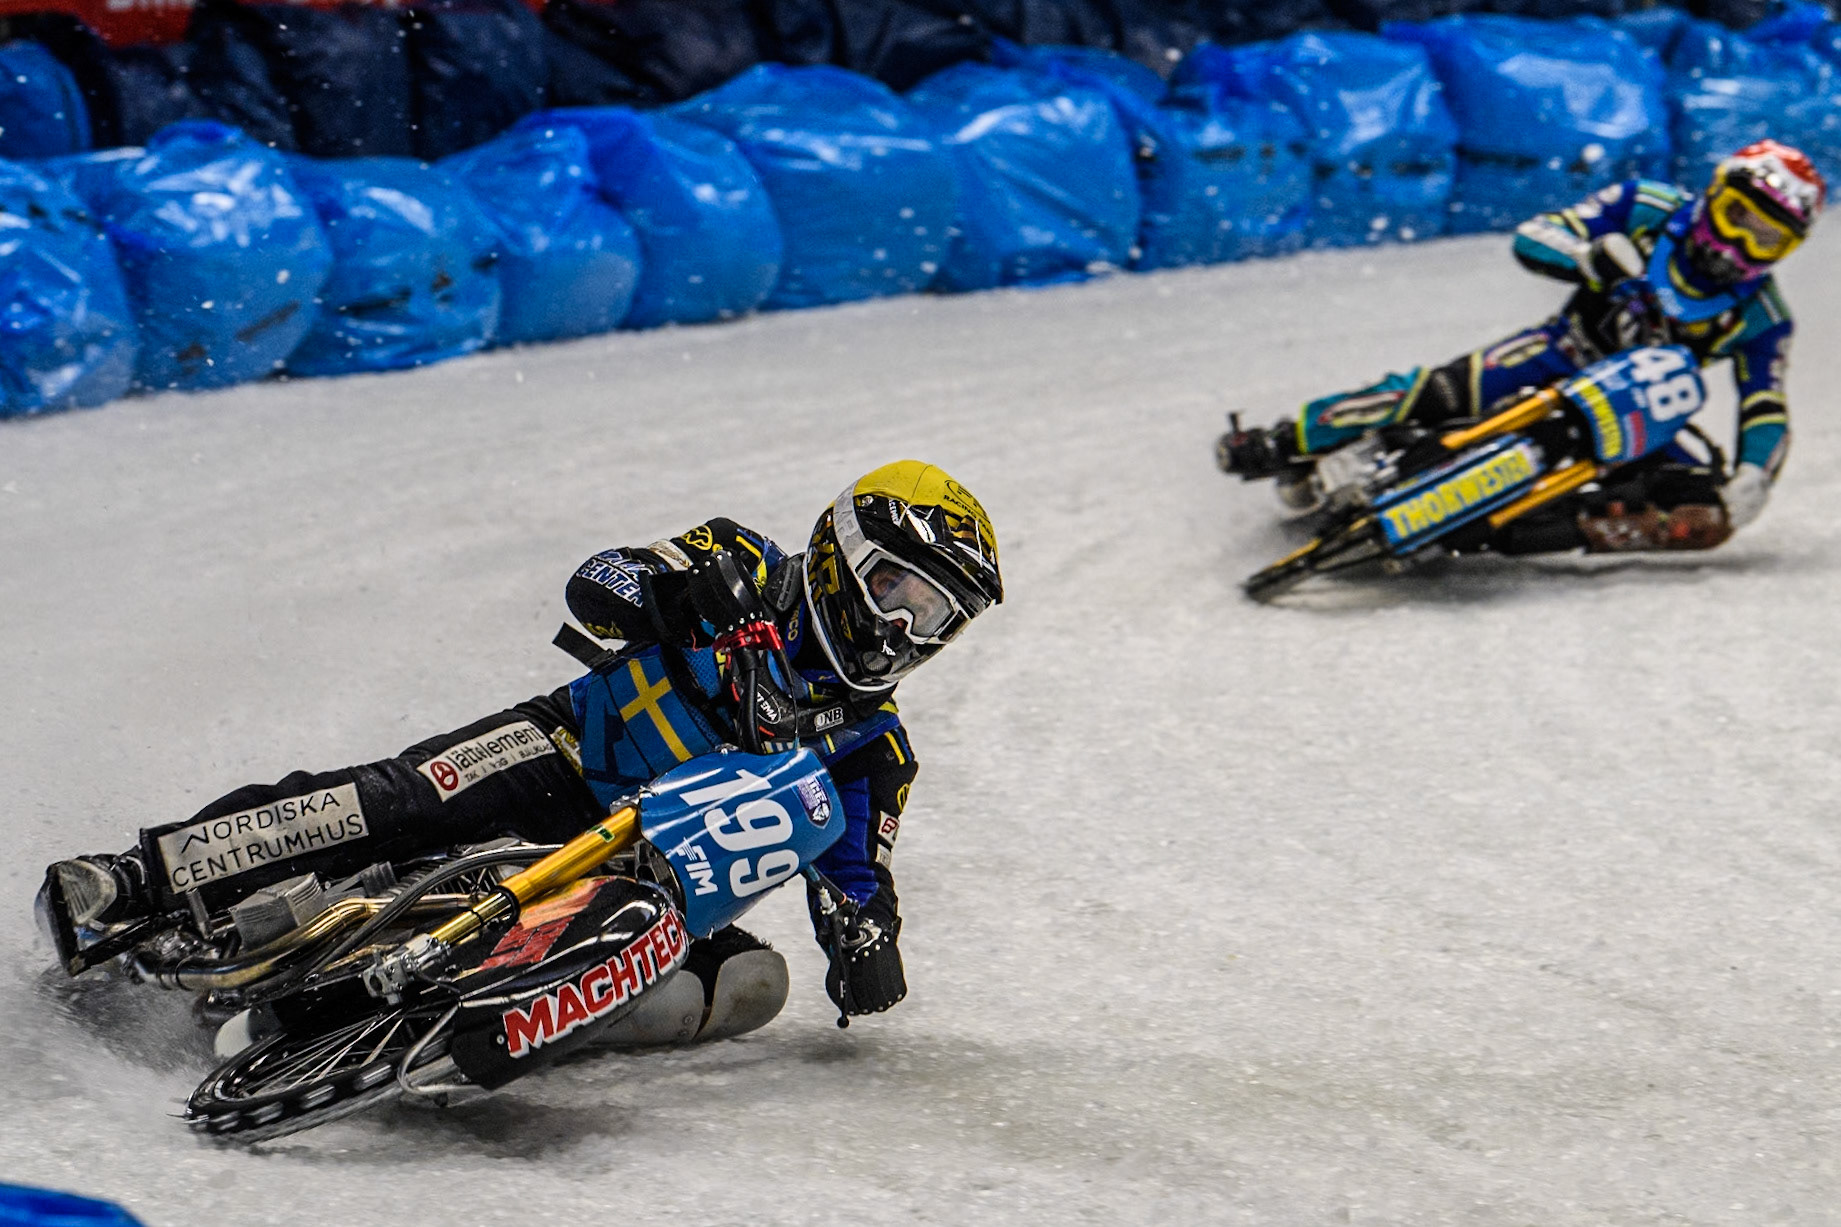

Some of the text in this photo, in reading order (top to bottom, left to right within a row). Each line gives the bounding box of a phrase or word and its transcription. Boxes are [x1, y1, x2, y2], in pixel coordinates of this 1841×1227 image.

[1628, 348, 1701, 422] 48
[172, 813, 364, 887] CENTRUMHUS
[181, 792, 341, 854] NORDISKA
[679, 769, 800, 898] 199
[676, 837, 718, 896] FIM
